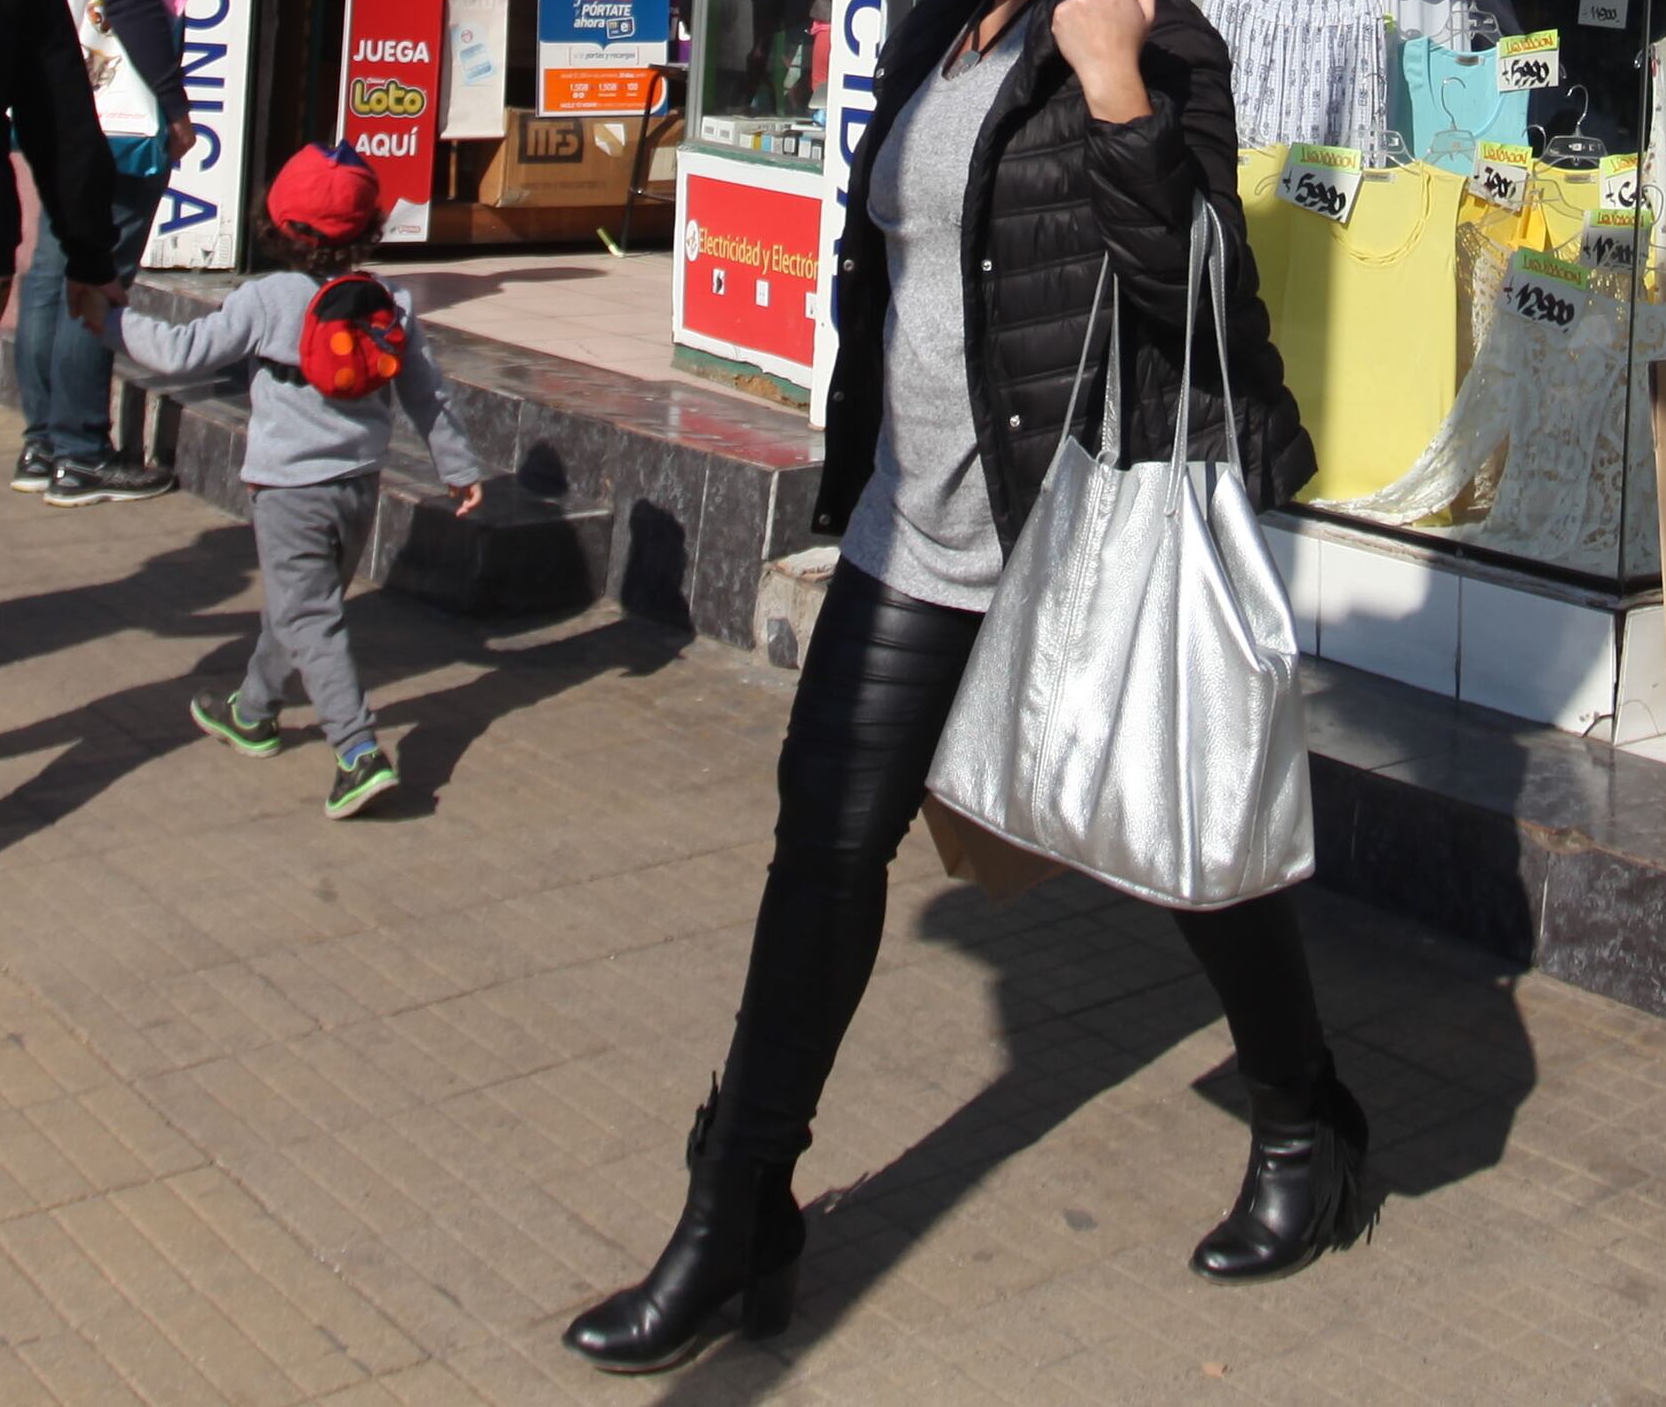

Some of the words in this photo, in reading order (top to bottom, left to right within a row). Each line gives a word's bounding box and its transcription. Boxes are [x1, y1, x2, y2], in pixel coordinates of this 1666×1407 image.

[581, 0, 633, 17] PÓRTATE
[573, 17, 606, 29] ahora
[352, 39, 430, 64] JUEGA
[349, 77, 427, 118] Loto
[354, 126, 420, 158] AQUÍ
[698, 227, 761, 268] Electricidad
[761, 248, 771, 276] y
